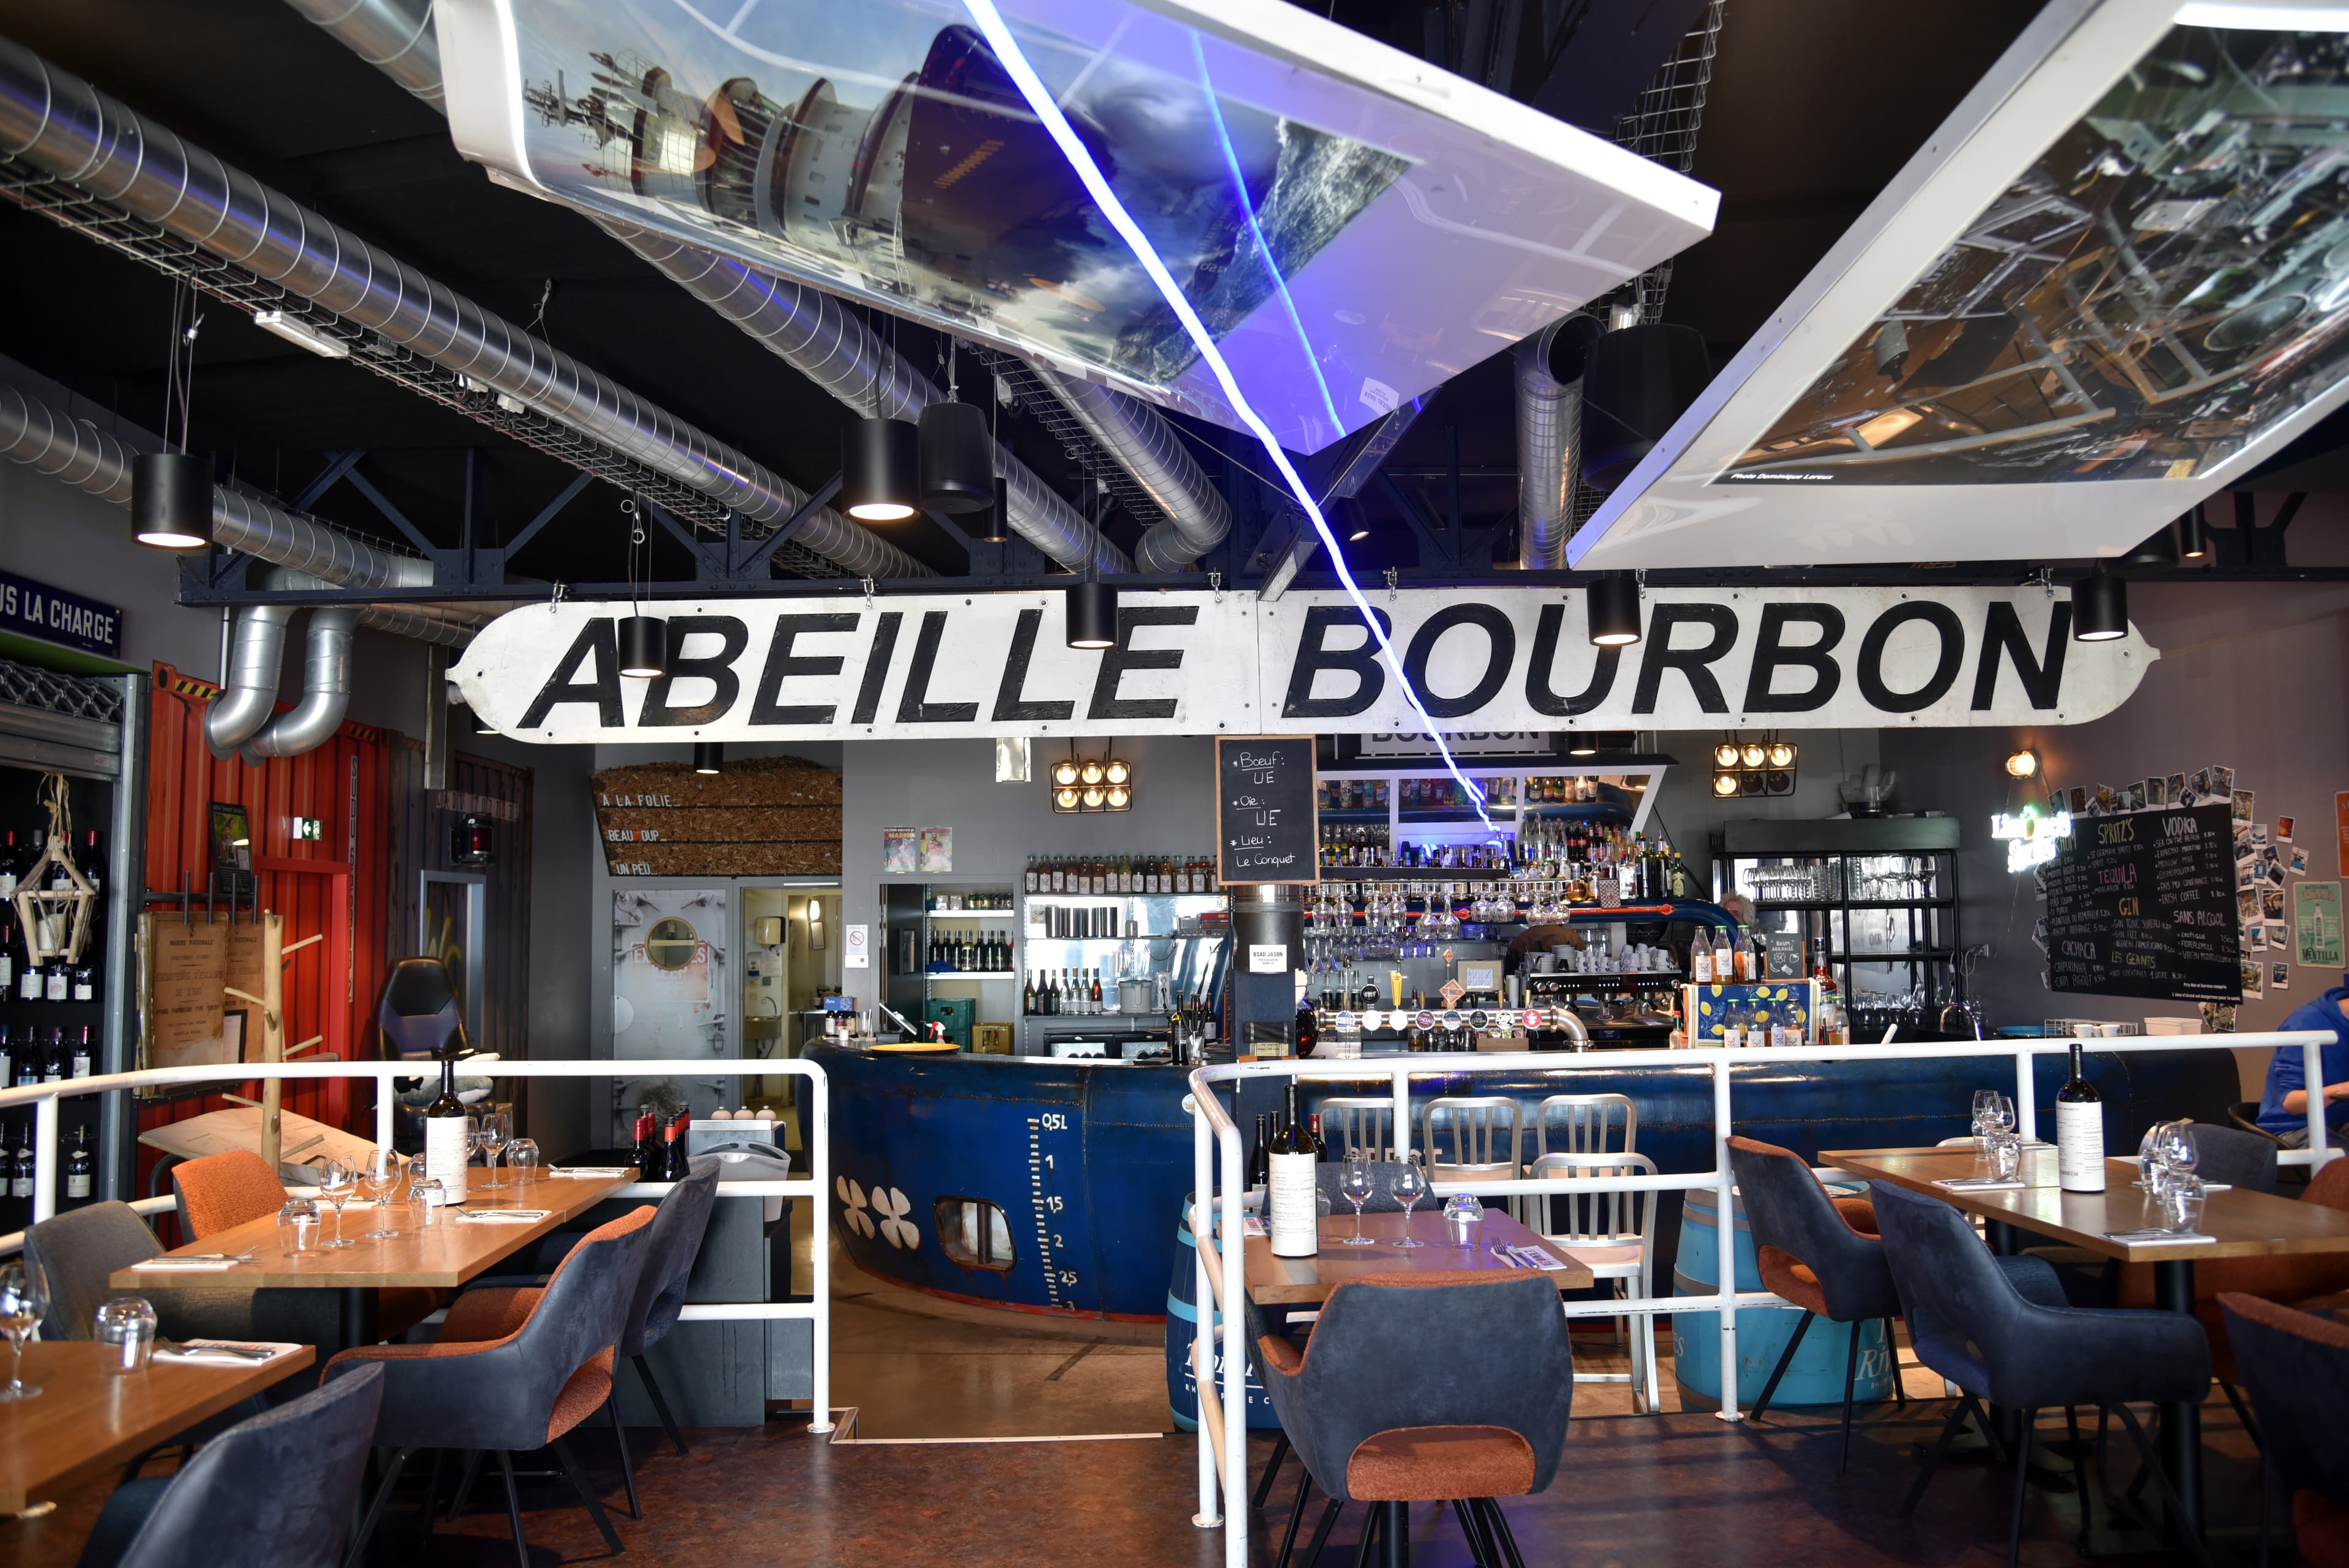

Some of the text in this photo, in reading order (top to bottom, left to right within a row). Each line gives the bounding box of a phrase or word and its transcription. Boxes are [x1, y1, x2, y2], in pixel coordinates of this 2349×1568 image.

[24, 591, 43, 624] LA
[50, 599, 114, 644] CHARGE
[516, 600, 2073, 729] ABEILLE BOURBON
[1254, 771, 1275, 784] UE
[615, 795, 631, 806] LA
[1256, 809, 1282, 826] UE
[2098, 817, 2134, 844] SPRITZ'S
[2162, 816, 2198, 838] VODKA
[2184, 833, 2200, 842] BEACH
[1236, 852, 1296, 868] Le Conquet
[616, 863, 629, 875] UN
[2098, 863, 2138, 885] TEQUILA
[2161, 893, 2178, 905] IRISH
[2180, 890, 2201, 902] COFFEE
[2118, 896, 2139, 916] GIN
[2113, 918, 2124, 928] GIN
[2173, 910, 2227, 927] SANS ALCOOL
[2302, 947, 2339, 962] MENTILLA
[1044, 1154, 1054, 1169] 1
[1053, 1234, 1063, 1247] 2
